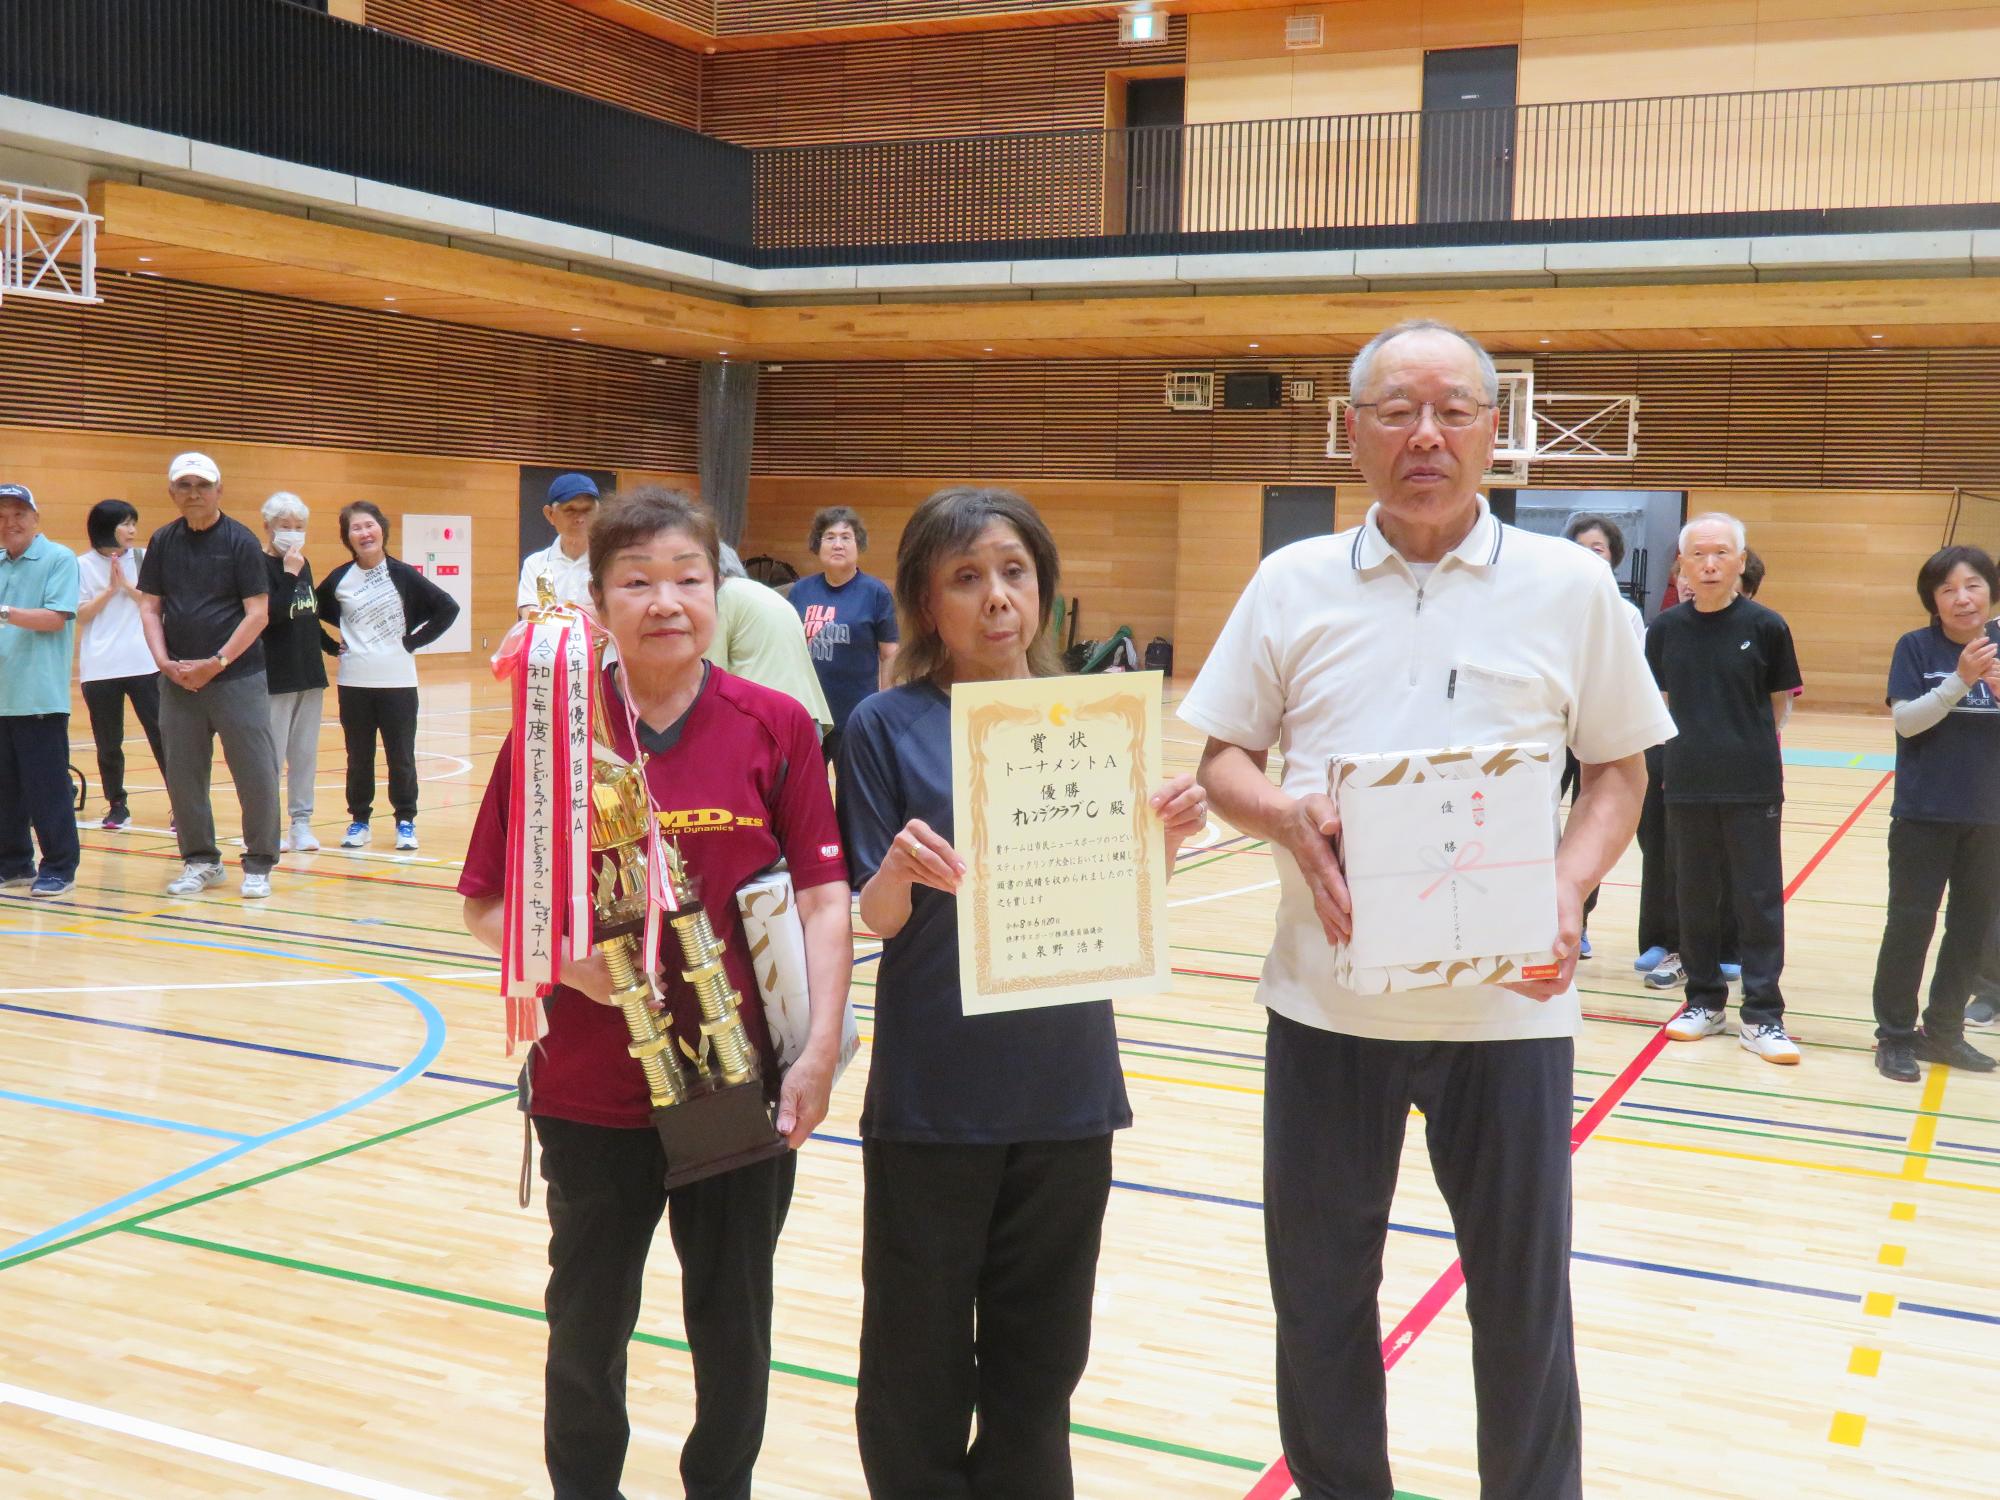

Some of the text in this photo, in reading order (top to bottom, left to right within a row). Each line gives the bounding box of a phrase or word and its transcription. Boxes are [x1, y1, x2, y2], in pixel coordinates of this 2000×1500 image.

[805, 605, 835, 621] FILA
[1967, 698, 1990, 706] SPORT
[684, 825, 734, 834] Dynamics
